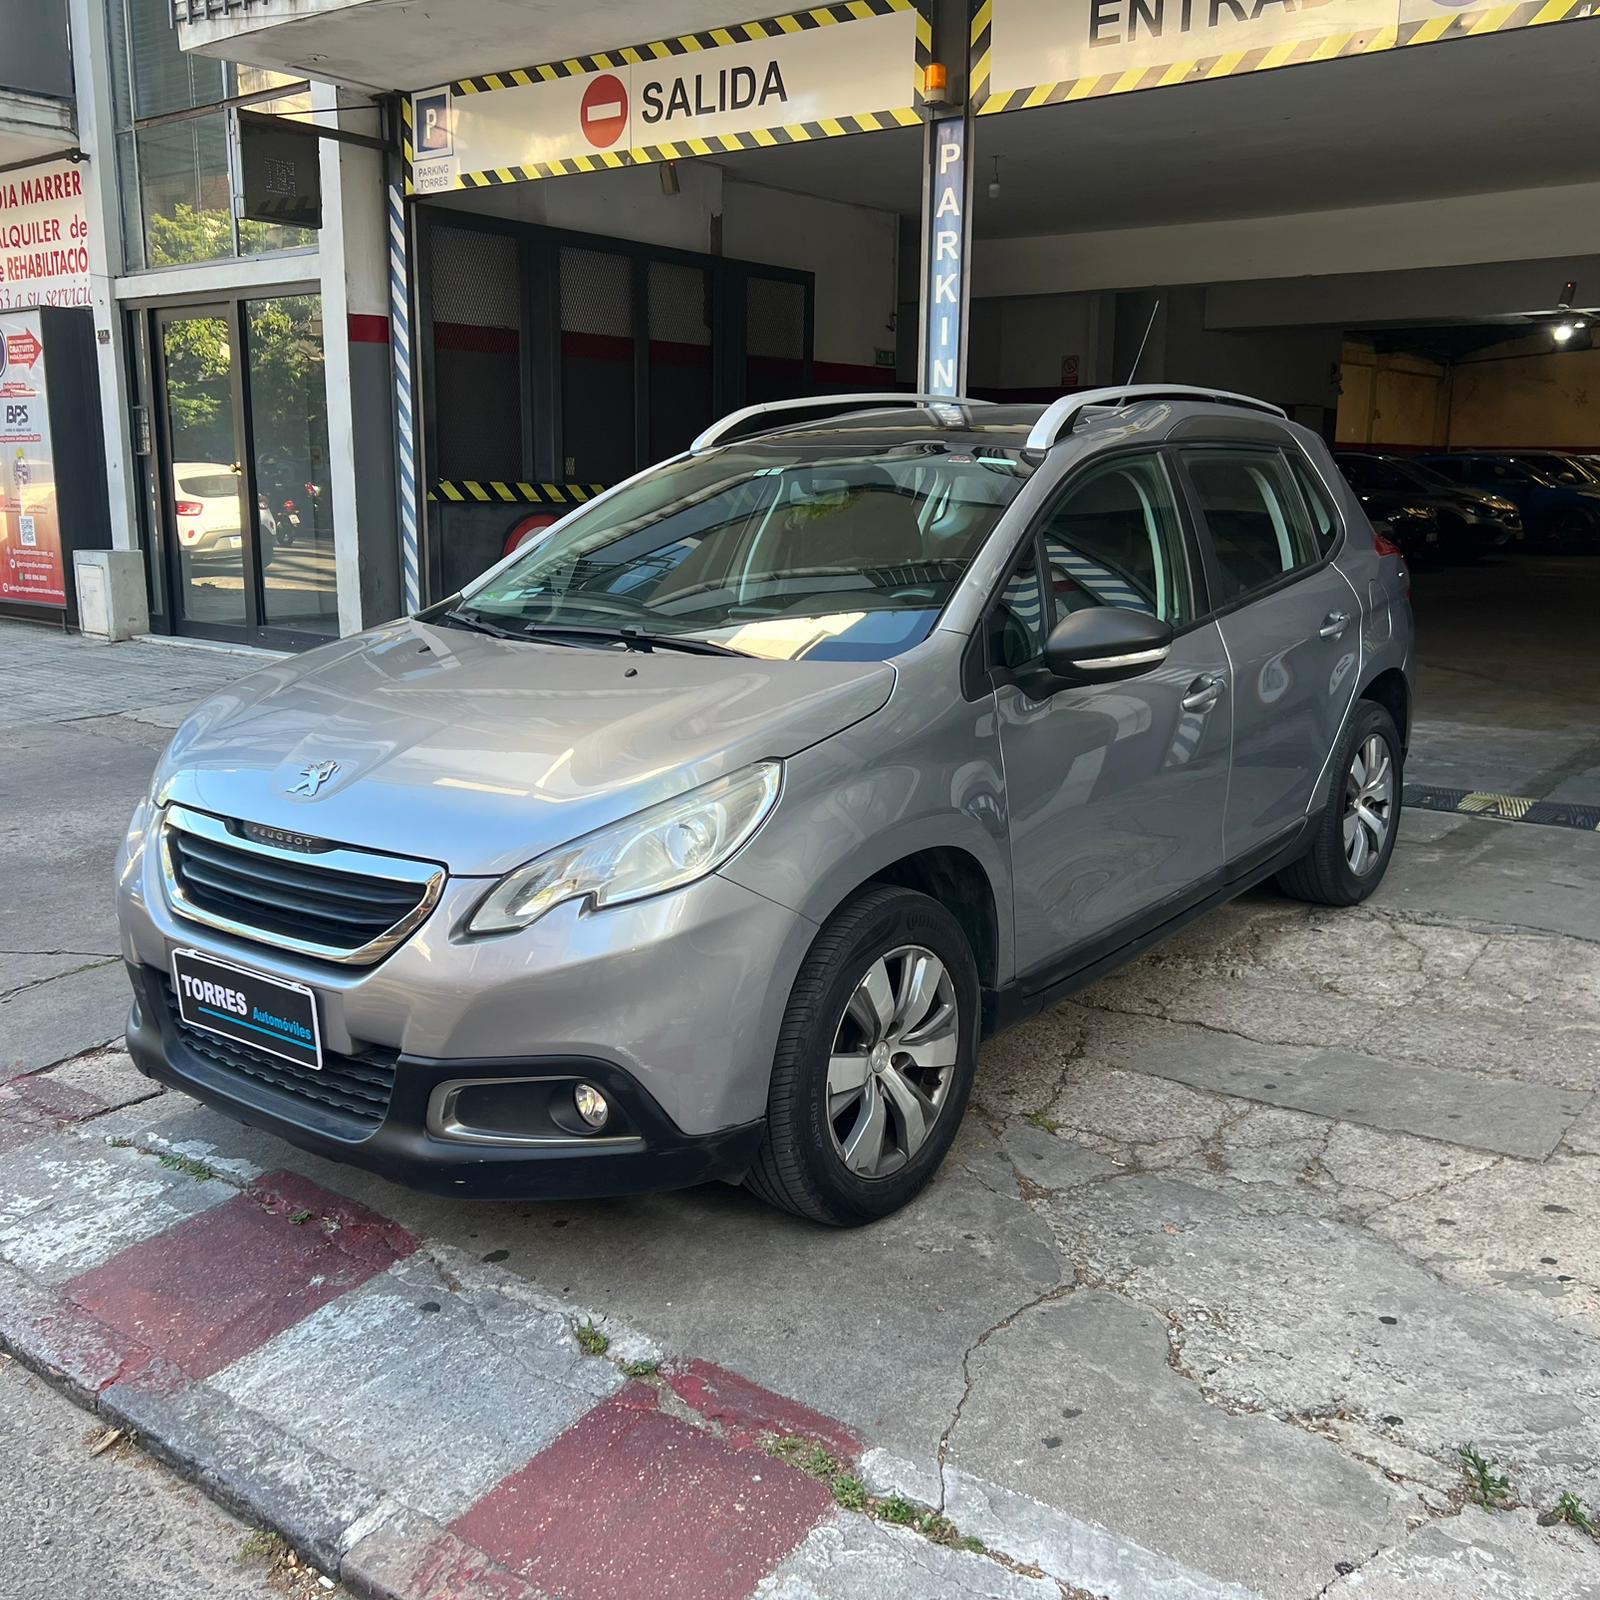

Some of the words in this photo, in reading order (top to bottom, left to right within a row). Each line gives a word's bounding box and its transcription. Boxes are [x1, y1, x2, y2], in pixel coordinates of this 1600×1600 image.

[642, 61, 788, 124] SALIDA
[426, 108, 437, 139] P
[418, 164, 449, 178] PARKING
[420, 177, 448, 189] TORRES
[21, 170, 82, 206] MARRER
[70, 214, 88, 239] de
[7, 240, 88, 281] REHABILITACIÓ
[933, 143, 960, 388] PARKIN
[6, 405, 28, 424] BPS
[252, 826, 312, 847] PEUGEOT
[181, 974, 247, 1016] TORRES
[253, 1007, 312, 1040] Automóviles
